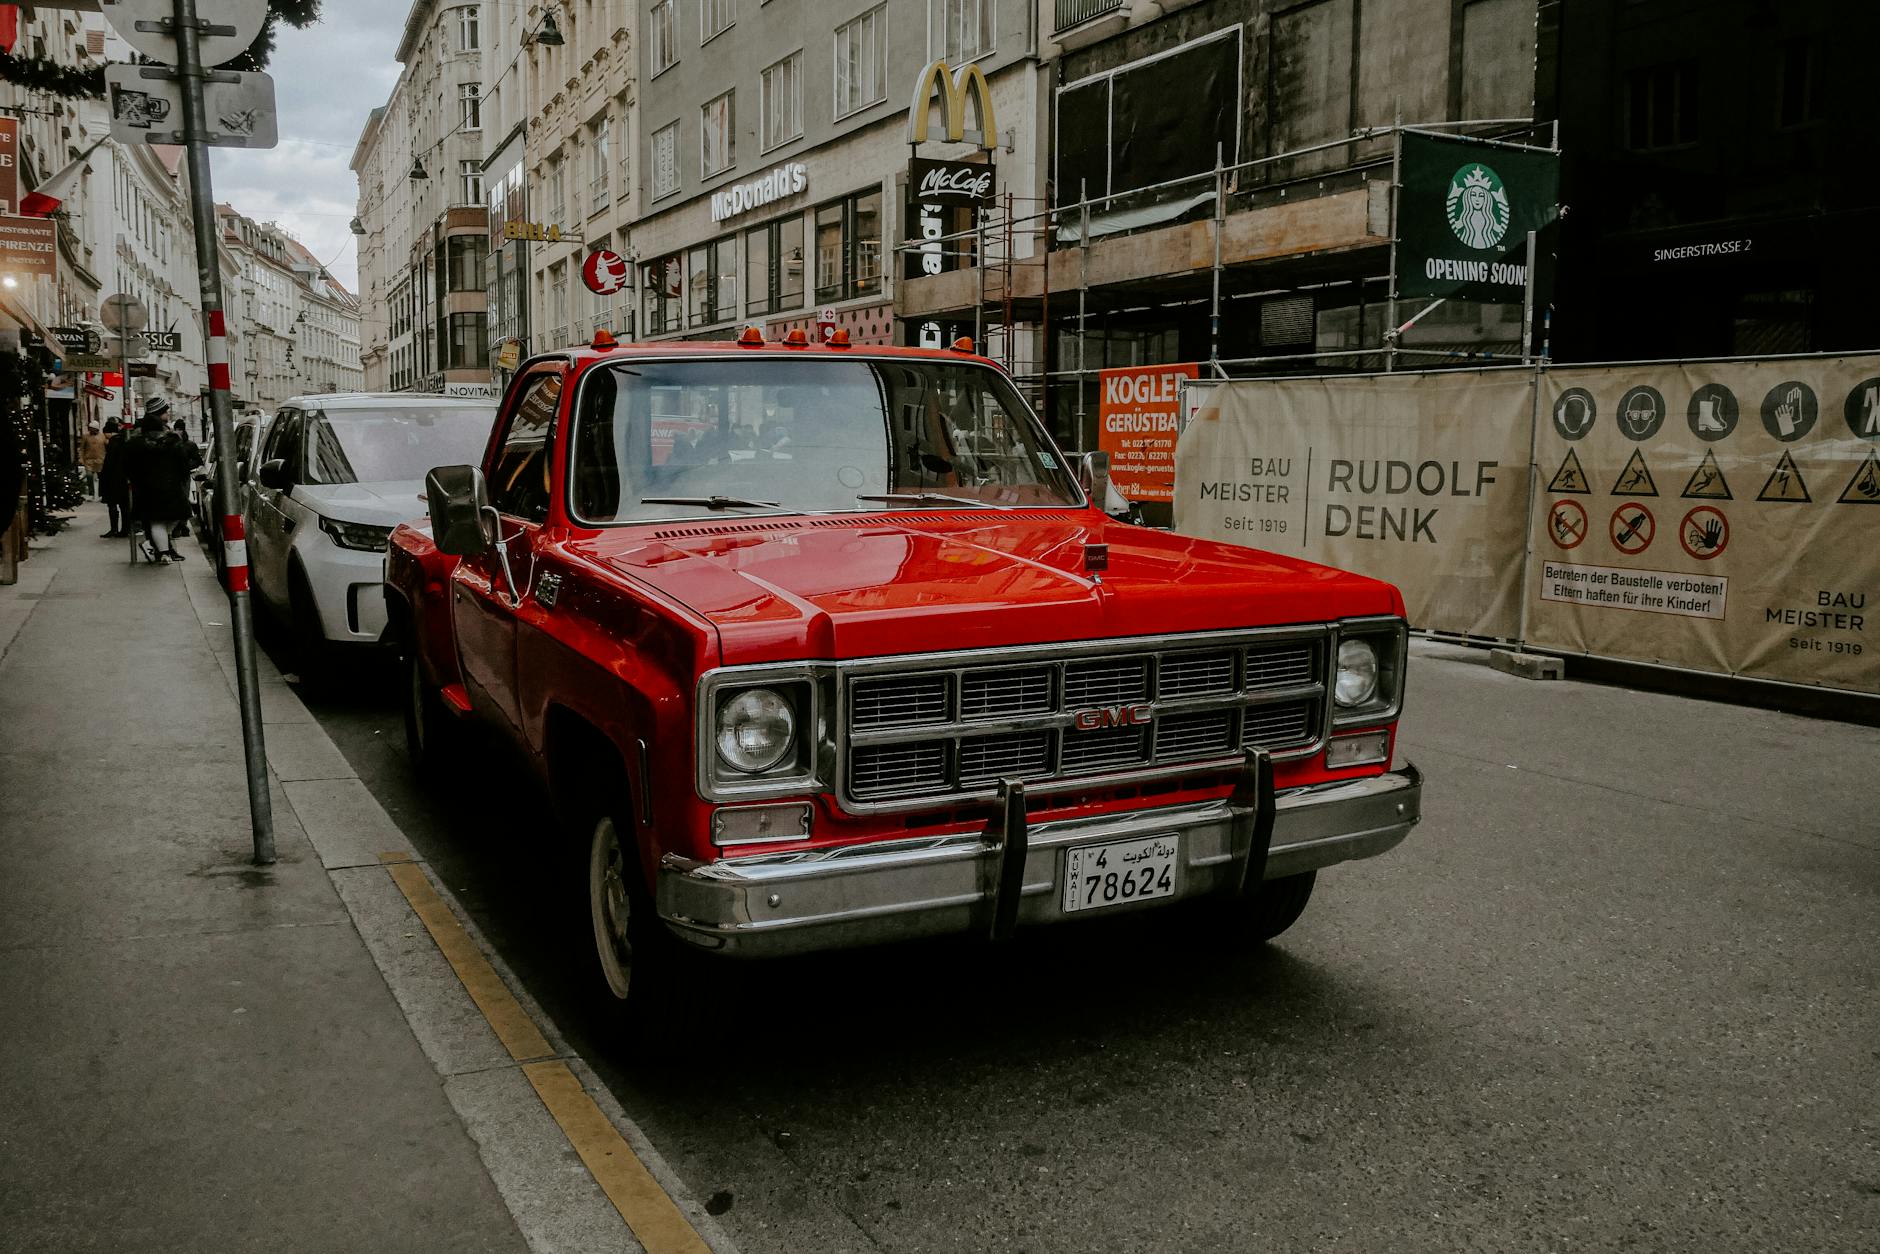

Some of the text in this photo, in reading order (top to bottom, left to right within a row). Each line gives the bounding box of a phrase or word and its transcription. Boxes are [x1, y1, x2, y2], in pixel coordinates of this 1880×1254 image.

[711, 162, 809, 222] McDonald's
[919, 167, 991, 198] McCafé
[504, 221, 561, 241] BILLA
[0, 240, 53, 252] FIRENZE
[1654, 239, 1752, 261] SINGERSTRASSE 2
[1426, 258, 1528, 286] OPENING SOON!
[1106, 407, 1178, 432] GERÜSTBA
[1251, 458, 1290, 477] BAU
[1328, 460, 1498, 497] RUDOLF
[1200, 482, 1289, 503] MEISTER
[1224, 517, 1287, 533] Seit 1919
[1325, 504, 1439, 543] DENK
[1546, 566, 1723, 595] Betreten der Baustelle verboten!
[1554, 584, 1711, 612] Eltern haften für ihre Kinder!
[1818, 591, 1864, 608] BAU
[1766, 608, 1863, 630] MEISTER
[1790, 638, 1862, 655] Seit 1919
[1075, 704, 1152, 730] GMC
[1096, 848, 1107, 869] 4
[1123, 843, 1175, 864] دولة الكويت
[1070, 852, 1080, 909] KUWAIT
[1086, 864, 1172, 904] 78624
